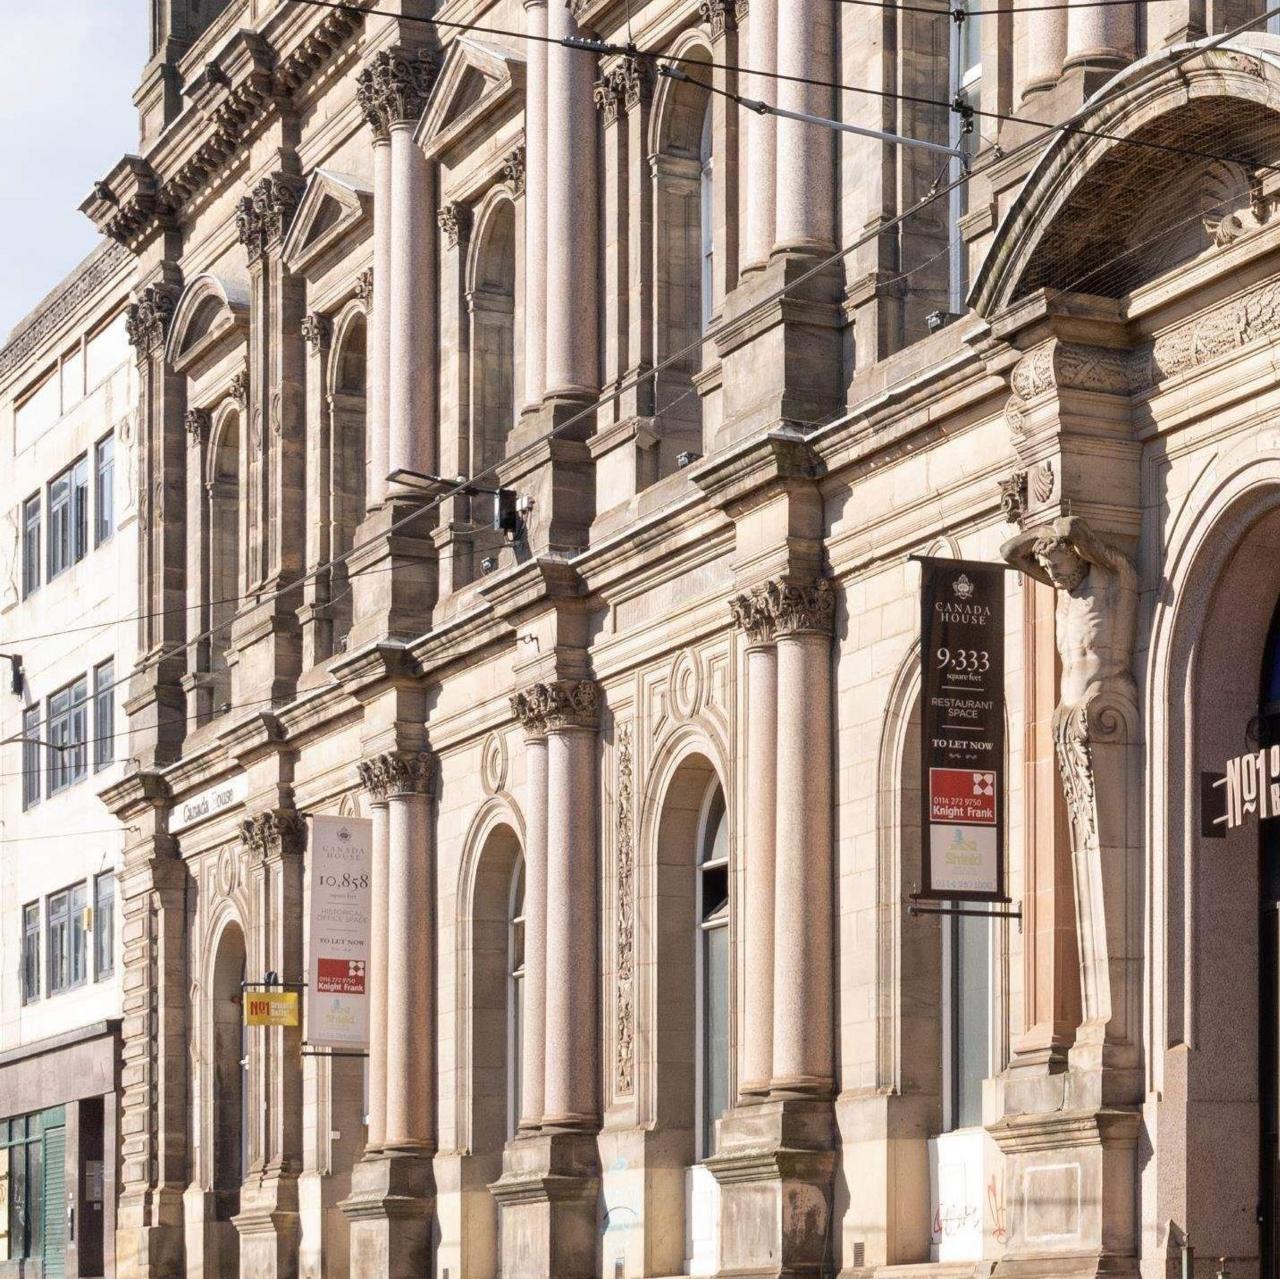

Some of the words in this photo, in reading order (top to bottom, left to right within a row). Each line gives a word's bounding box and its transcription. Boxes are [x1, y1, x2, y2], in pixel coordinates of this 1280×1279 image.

[935, 602, 991, 615] CANADA
[941, 613, 986, 625] HOUSE
[936, 647, 990, 673] 9,333
[946, 673, 967, 681] square
[969, 672, 982, 681] feet
[931, 698, 994, 710] RESTAURANT
[948, 708, 978, 718] SPACE
[932, 739, 947, 748] TO
[949, 739, 969, 749] LET
[970, 741, 994, 750] NOW
[951, 797, 963, 805] 272
[964, 798, 982, 806] 9750
[184, 797, 209, 822] Canada
[933, 806, 964, 818] Knight
[967, 808, 993, 818] Frank
[323, 845, 365, 855] CANADA
[326, 852, 361, 861] HOUSE
[318, 982, 342, 992] Knight
[344, 984, 364, 992] Frank
